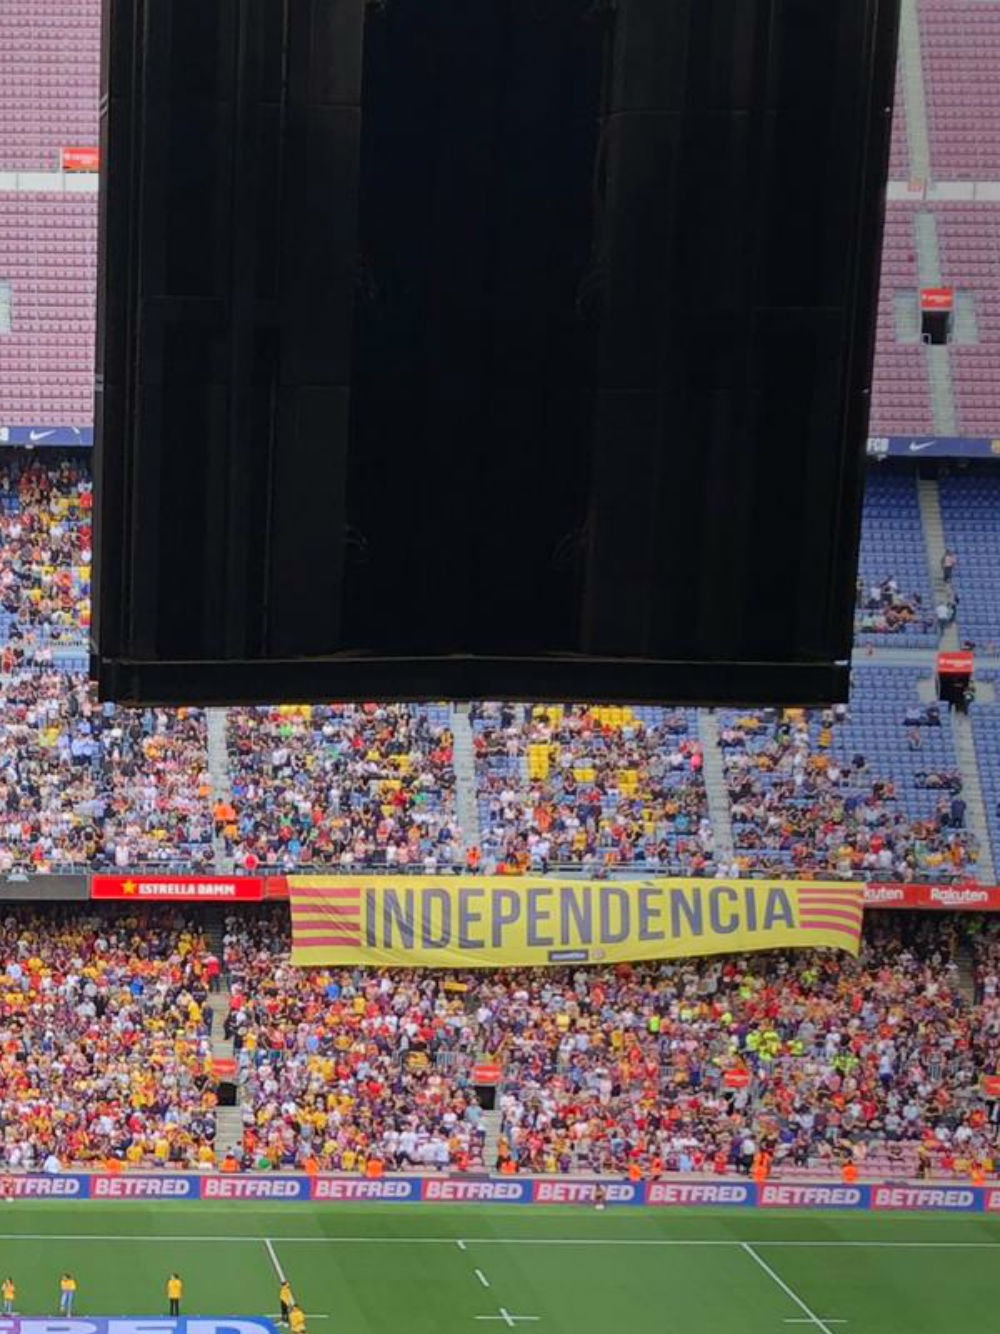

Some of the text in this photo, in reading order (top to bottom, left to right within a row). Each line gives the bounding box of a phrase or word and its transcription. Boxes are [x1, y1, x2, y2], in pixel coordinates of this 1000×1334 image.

[139, 882, 236, 896] ESTRELLA DAMM
[931, 887, 989, 902] Rakuten
[365, 880, 796, 949] INDEPENDÈNCIA
[96, 1178, 190, 1195] BETFRED
[205, 1179, 300, 1195] BETFRED
[315, 1180, 410, 1197] BETFRED
[426, 1181, 522, 1198] BETFRED
[650, 1185, 746, 1201] BETFRED
[761, 1187, 860, 1204] BETFRED
[875, 1188, 974, 1207] BETFRED
